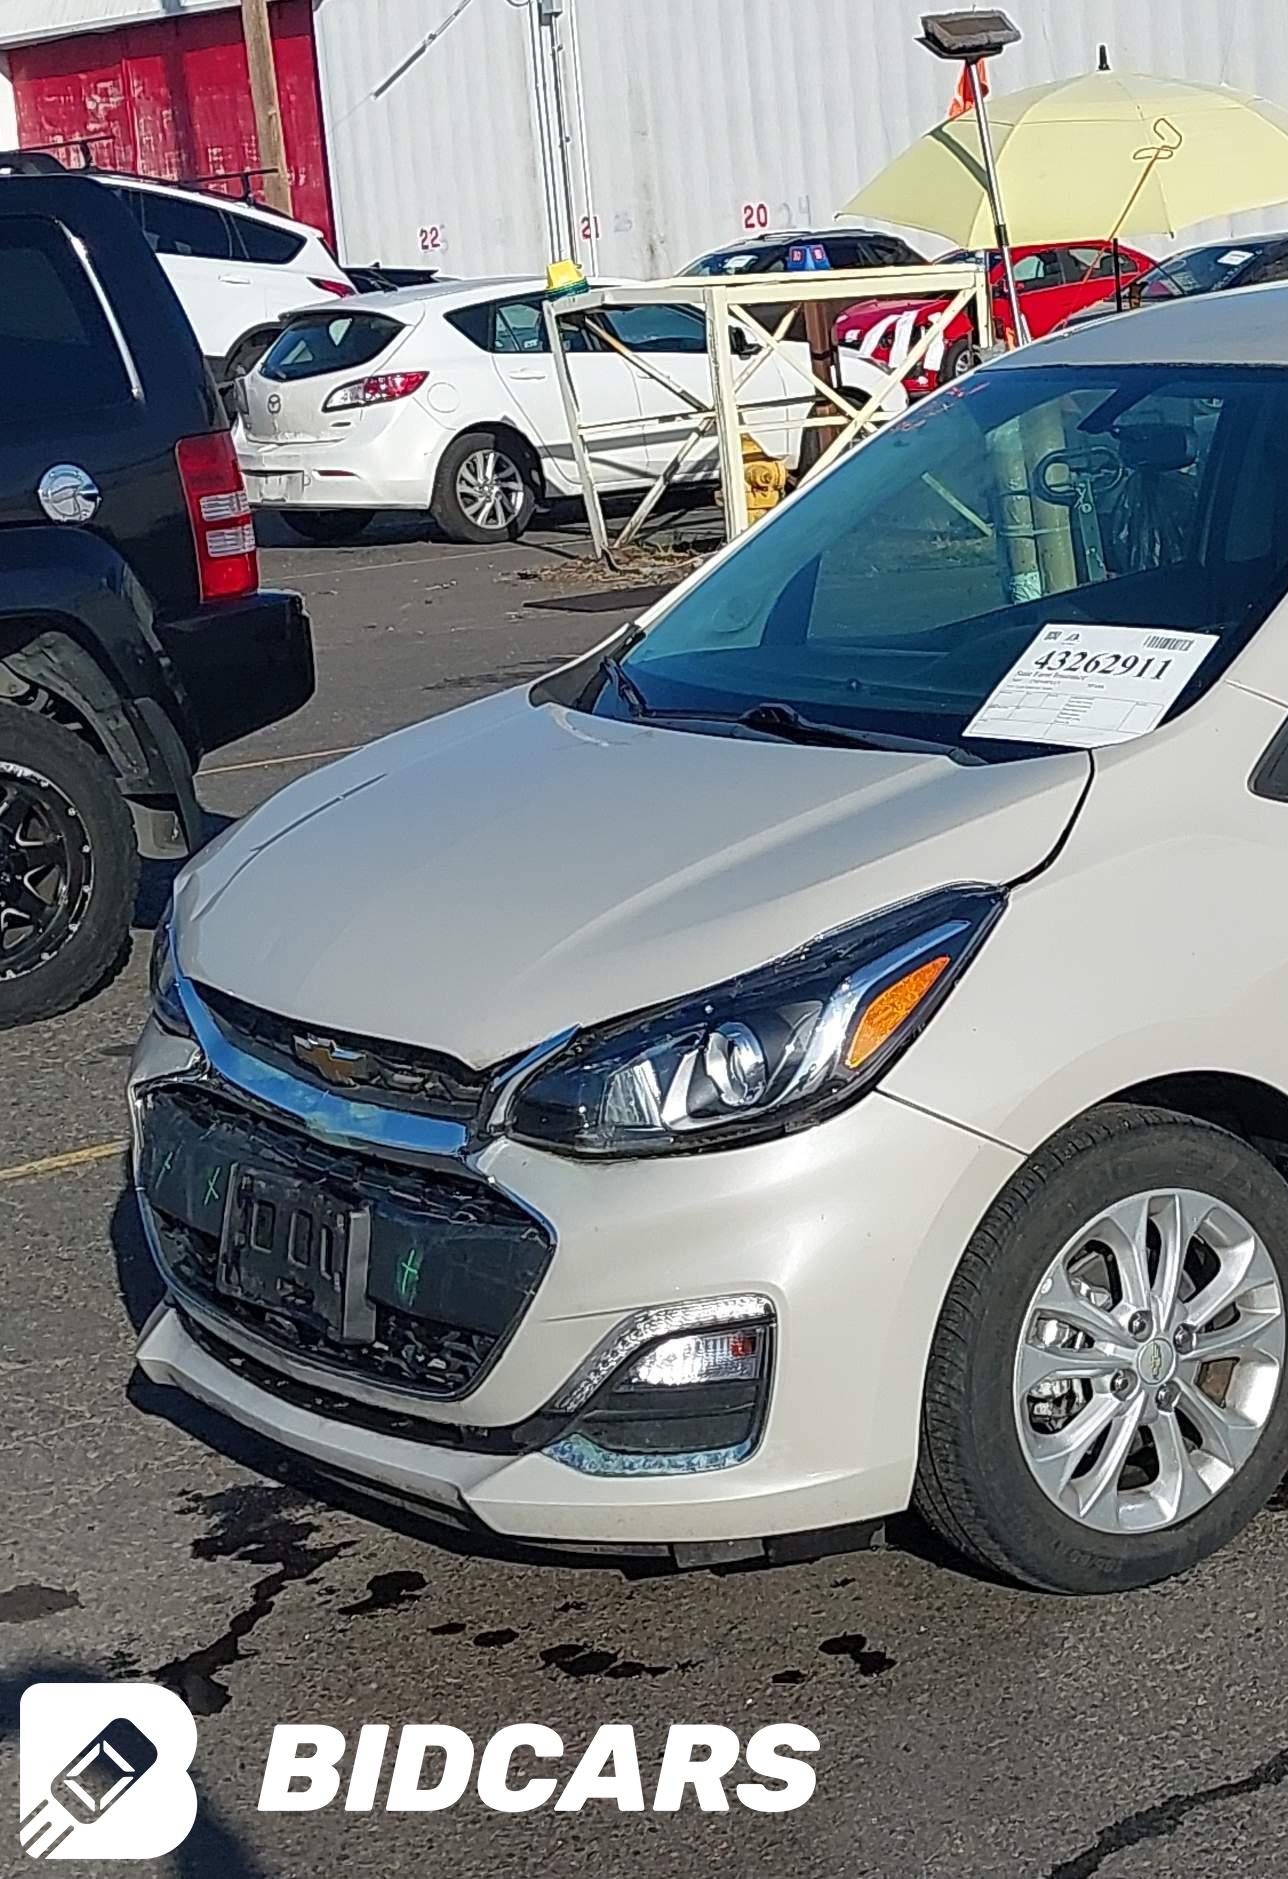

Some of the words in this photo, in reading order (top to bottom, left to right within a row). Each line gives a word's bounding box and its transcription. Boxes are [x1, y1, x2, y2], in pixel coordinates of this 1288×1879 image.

[580, 215, 600, 240] 21
[743, 203, 768, 229] 20
[419, 226, 441, 251] 22
[1034, 649, 1174, 681] 43262911
